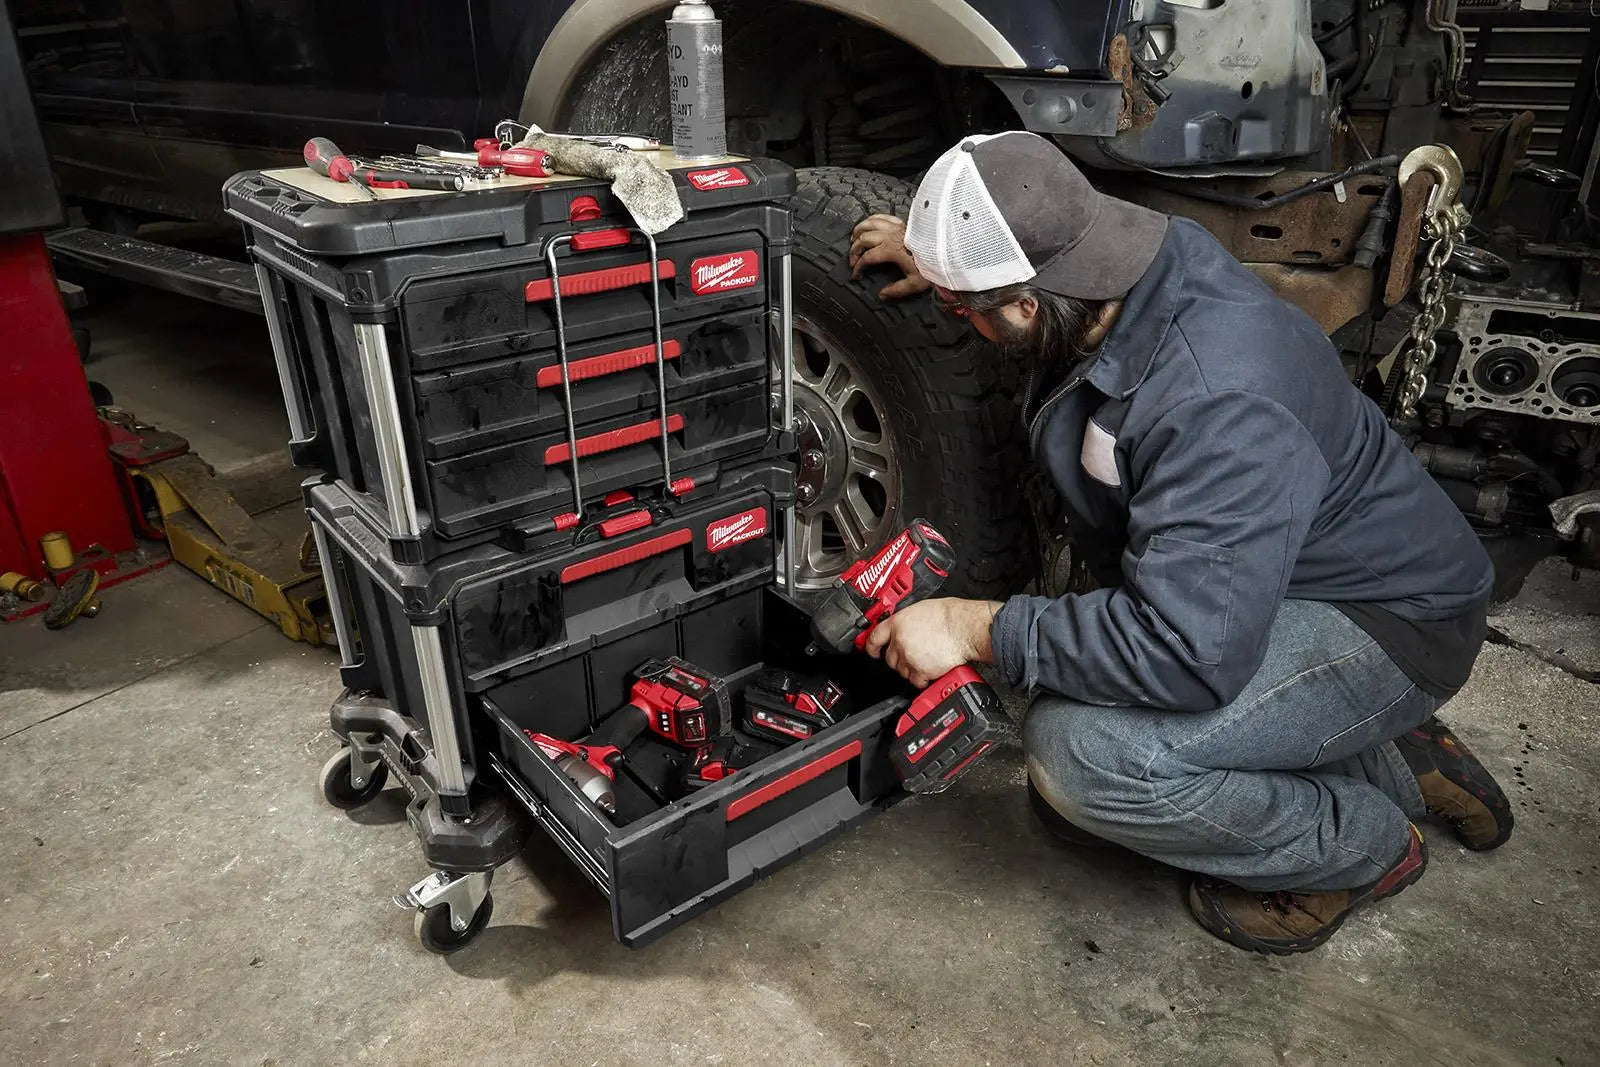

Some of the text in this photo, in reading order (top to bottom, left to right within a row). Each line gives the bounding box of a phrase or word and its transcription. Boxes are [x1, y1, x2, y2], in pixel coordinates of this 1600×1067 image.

[694, 256, 745, 286] Milwaukee
[720, 275, 757, 288] PACKOUT
[709, 514, 754, 544] Milwaukee
[732, 527, 766, 543] PACKOUT
[854, 534, 908, 595] Milwaukee
